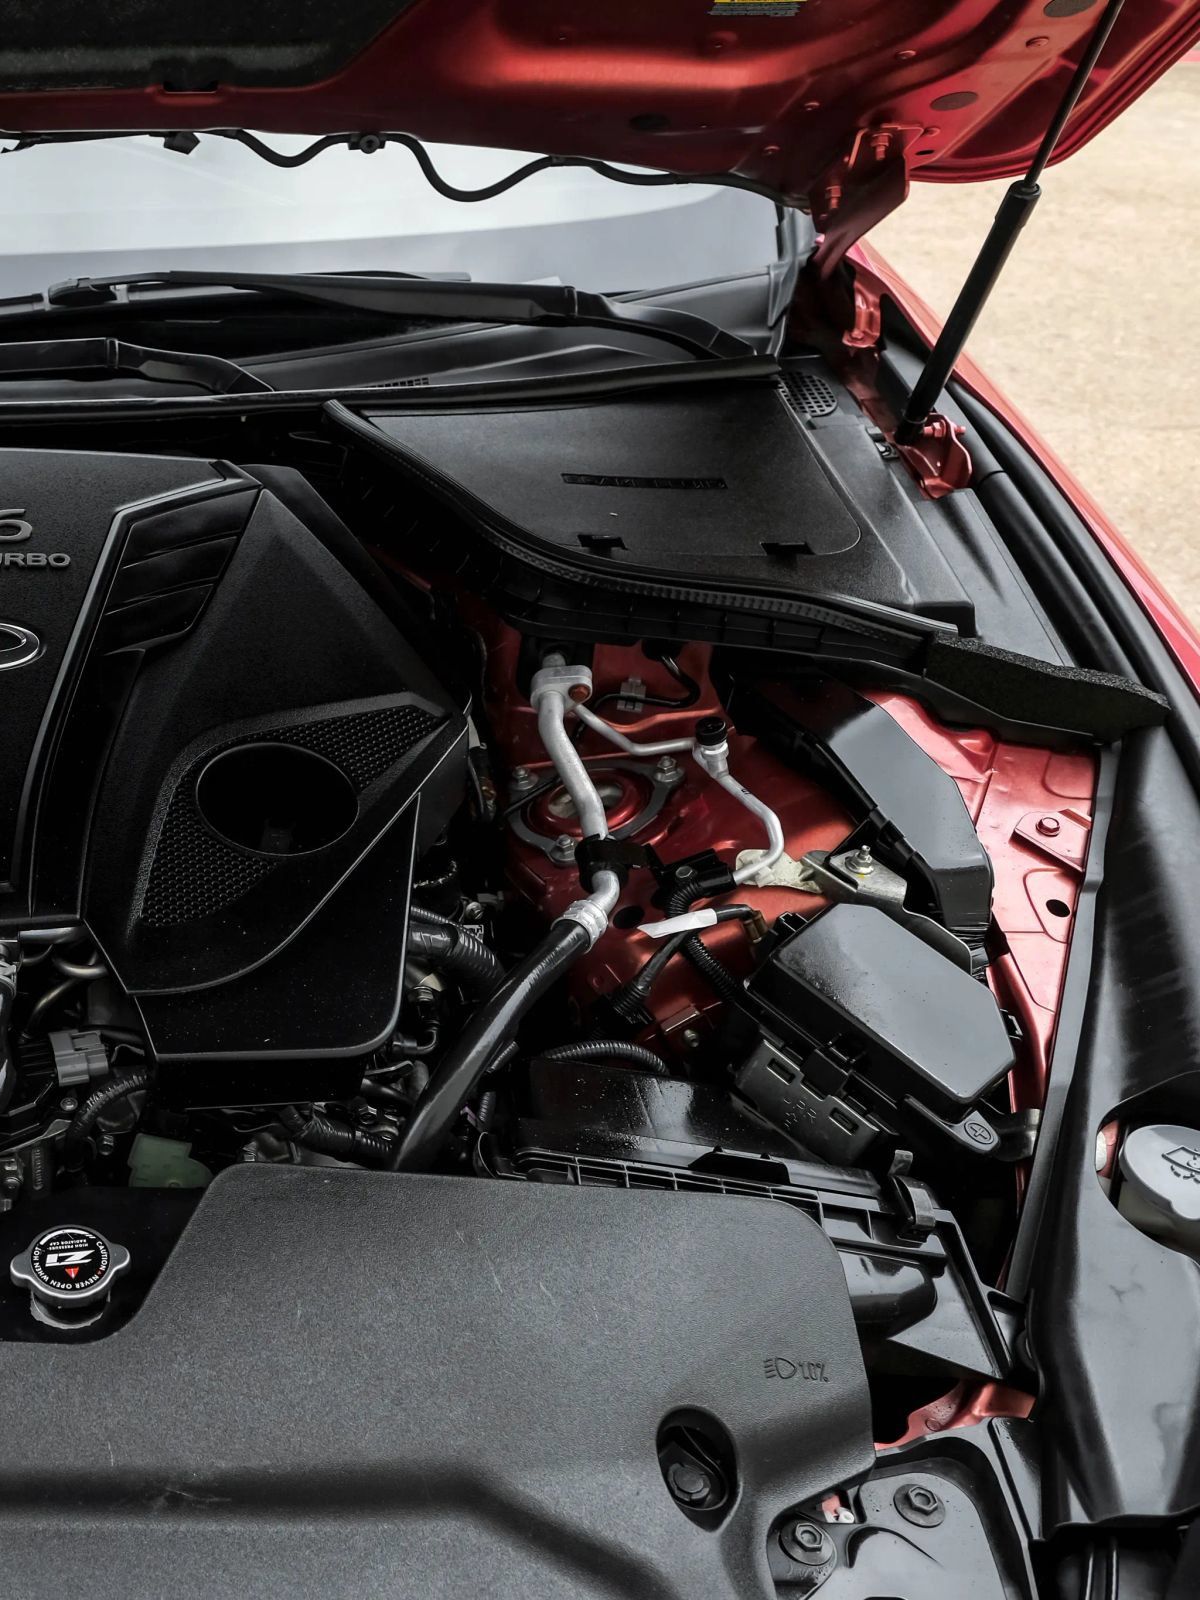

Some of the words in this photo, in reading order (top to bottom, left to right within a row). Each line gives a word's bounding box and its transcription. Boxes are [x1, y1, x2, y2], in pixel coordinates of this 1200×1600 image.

[33, 1246, 42, 1261] HOT
[96, 1241, 108, 1271] CAUTION
[33, 1262, 49, 1282] WHEN
[50, 1280, 72, 1289] OPEN
[75, 1274, 99, 1289] NEVER
